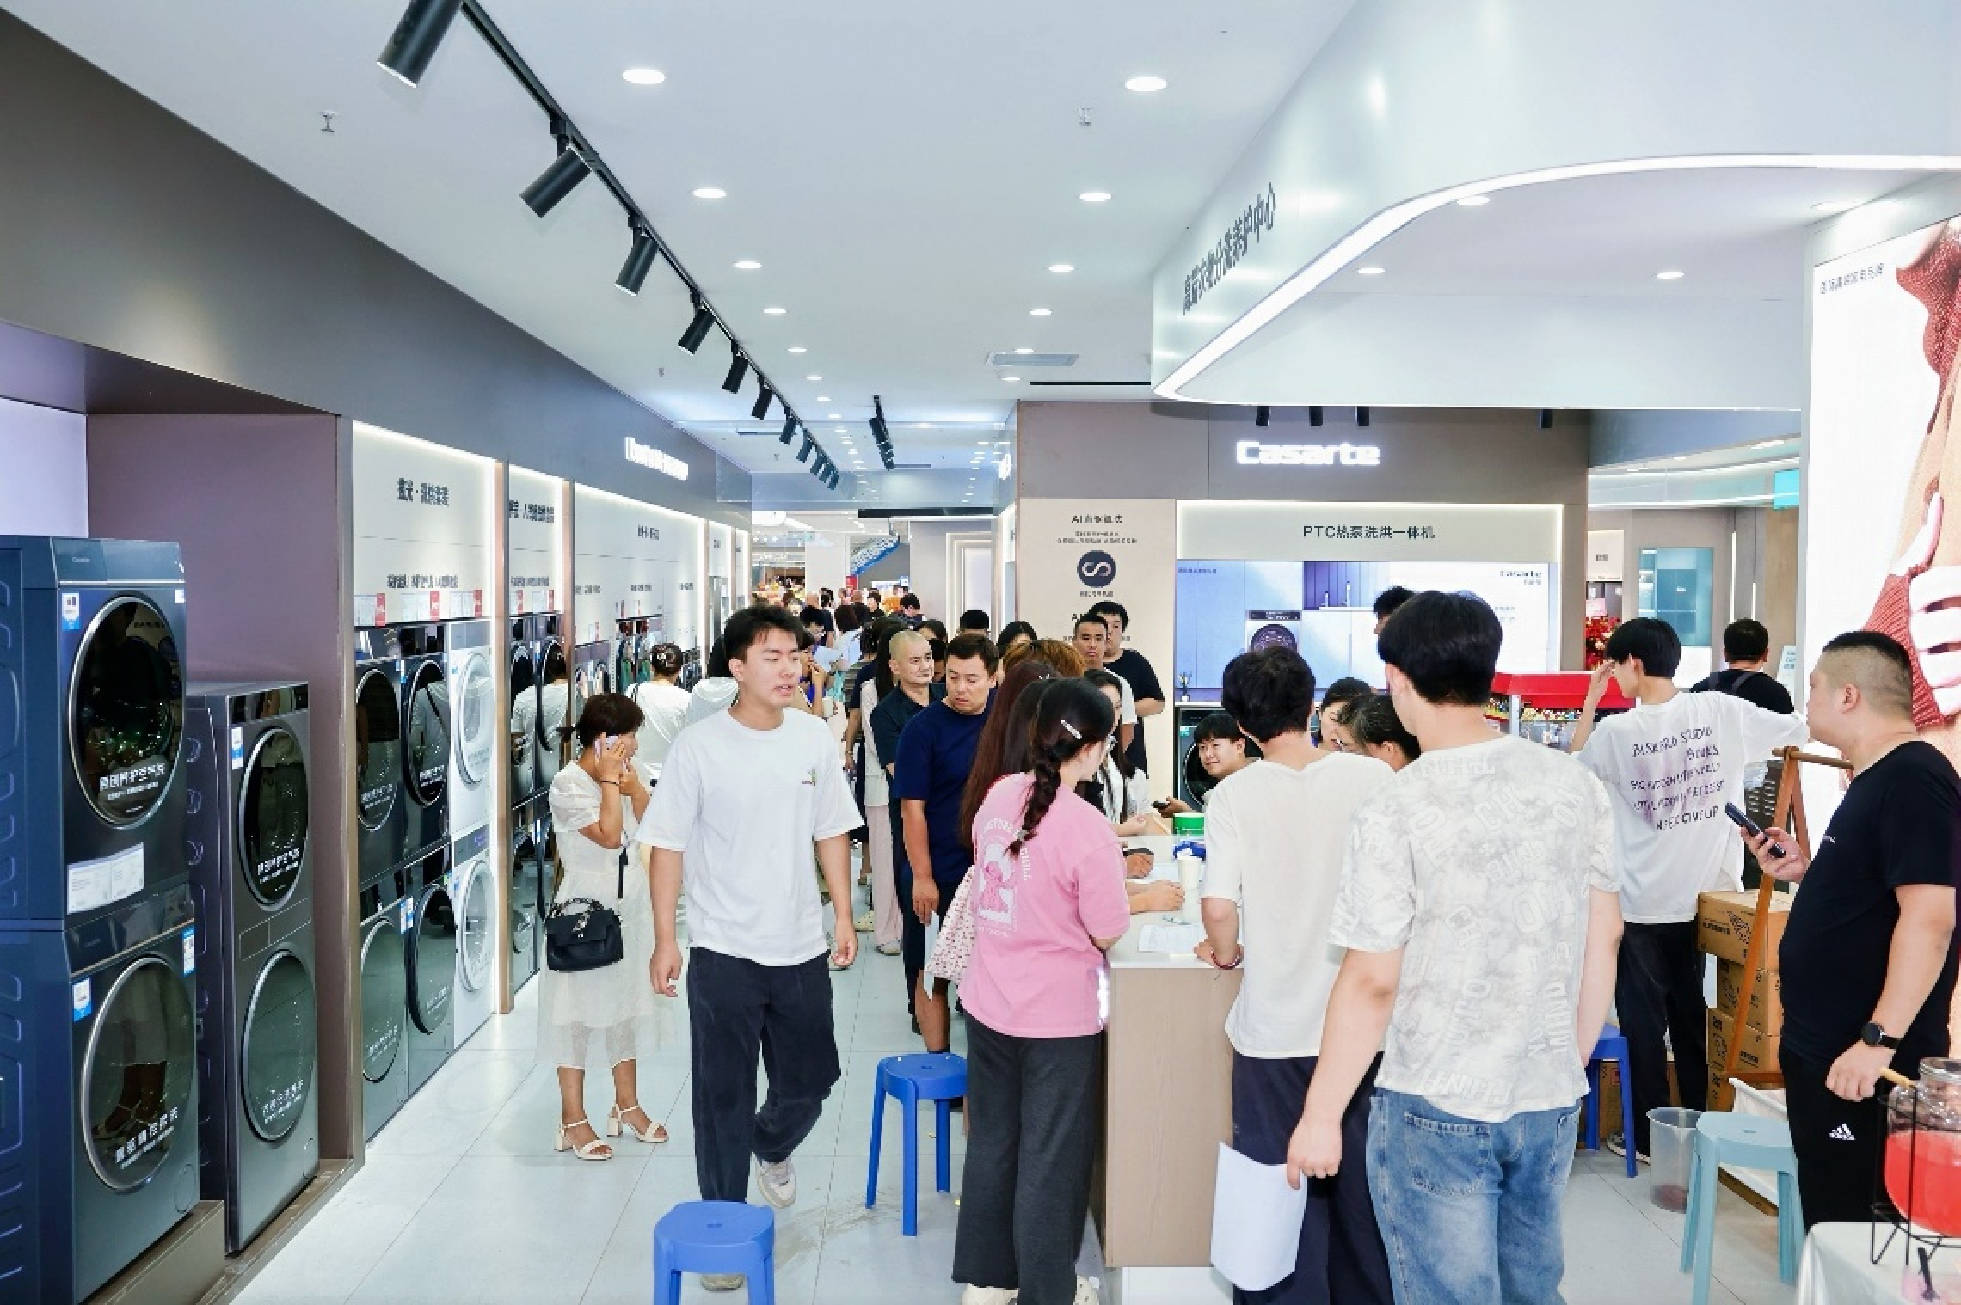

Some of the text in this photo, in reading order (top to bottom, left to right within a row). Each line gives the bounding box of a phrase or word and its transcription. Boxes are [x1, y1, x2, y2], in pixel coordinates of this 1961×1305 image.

[1237, 440, 1381, 465] Casarte
[1303, 524, 1436, 540] PTC热泵洗烘一体机
